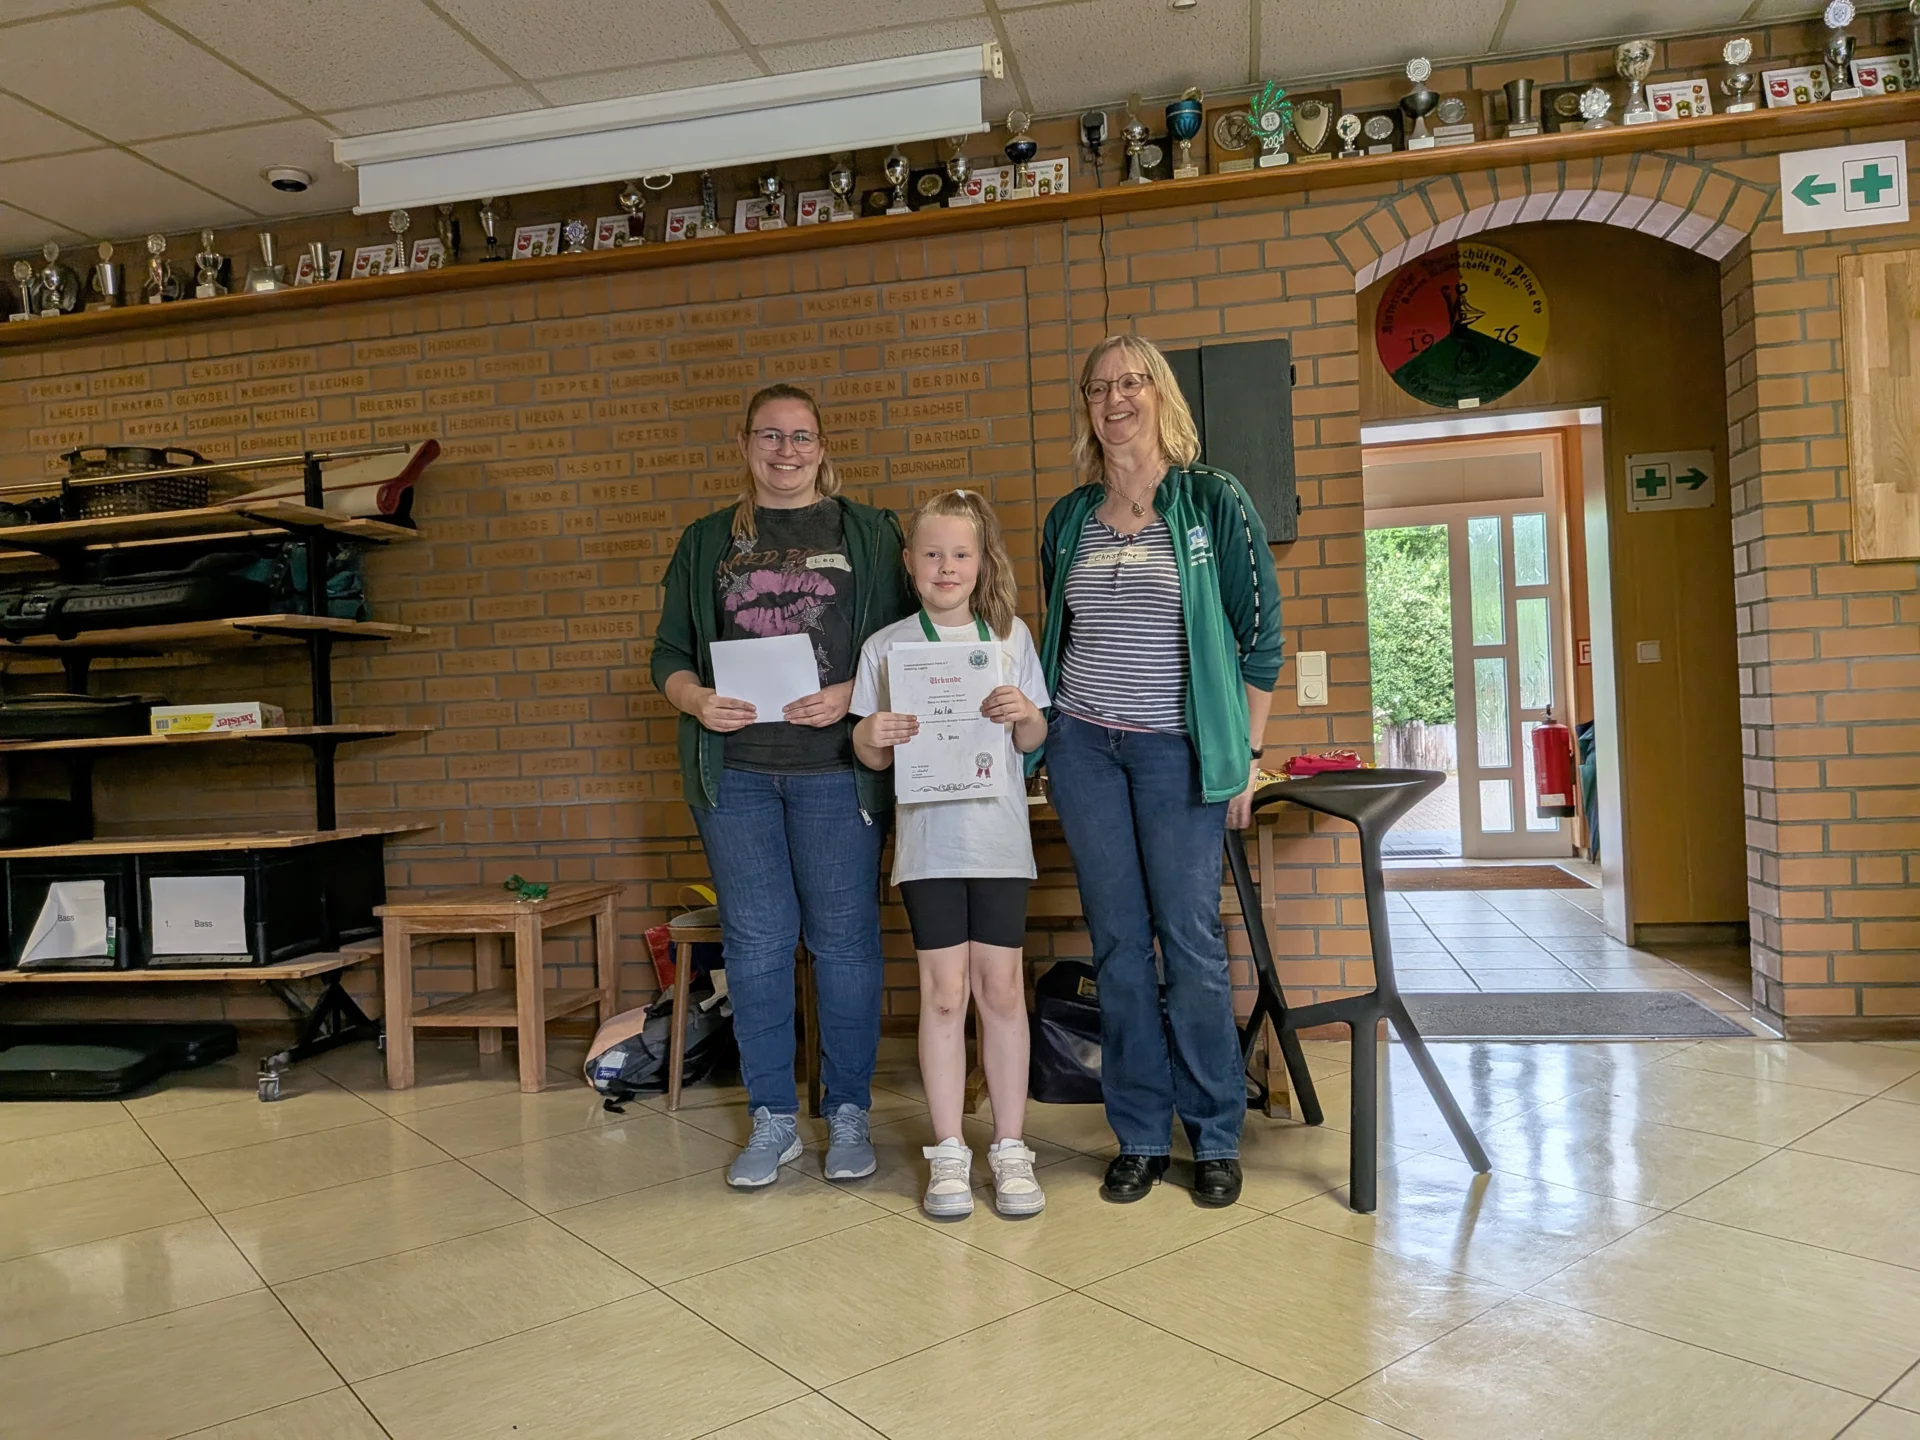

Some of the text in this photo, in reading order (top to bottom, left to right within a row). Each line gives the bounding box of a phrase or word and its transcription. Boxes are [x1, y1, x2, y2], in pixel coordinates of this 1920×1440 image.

[910, 313, 977, 330] NITSCH
[833, 379, 896, 396] JÜRGEN
[912, 371, 980, 389] GERBING
[671, 395, 741, 411] SCHIFFNER
[914, 428, 981, 444] BARTHOLD
[930, 676, 961, 684] Urkunde
[216, 712, 258, 729] Twister
[57, 914, 75, 922] Bass
[194, 920, 213, 928] Bass
